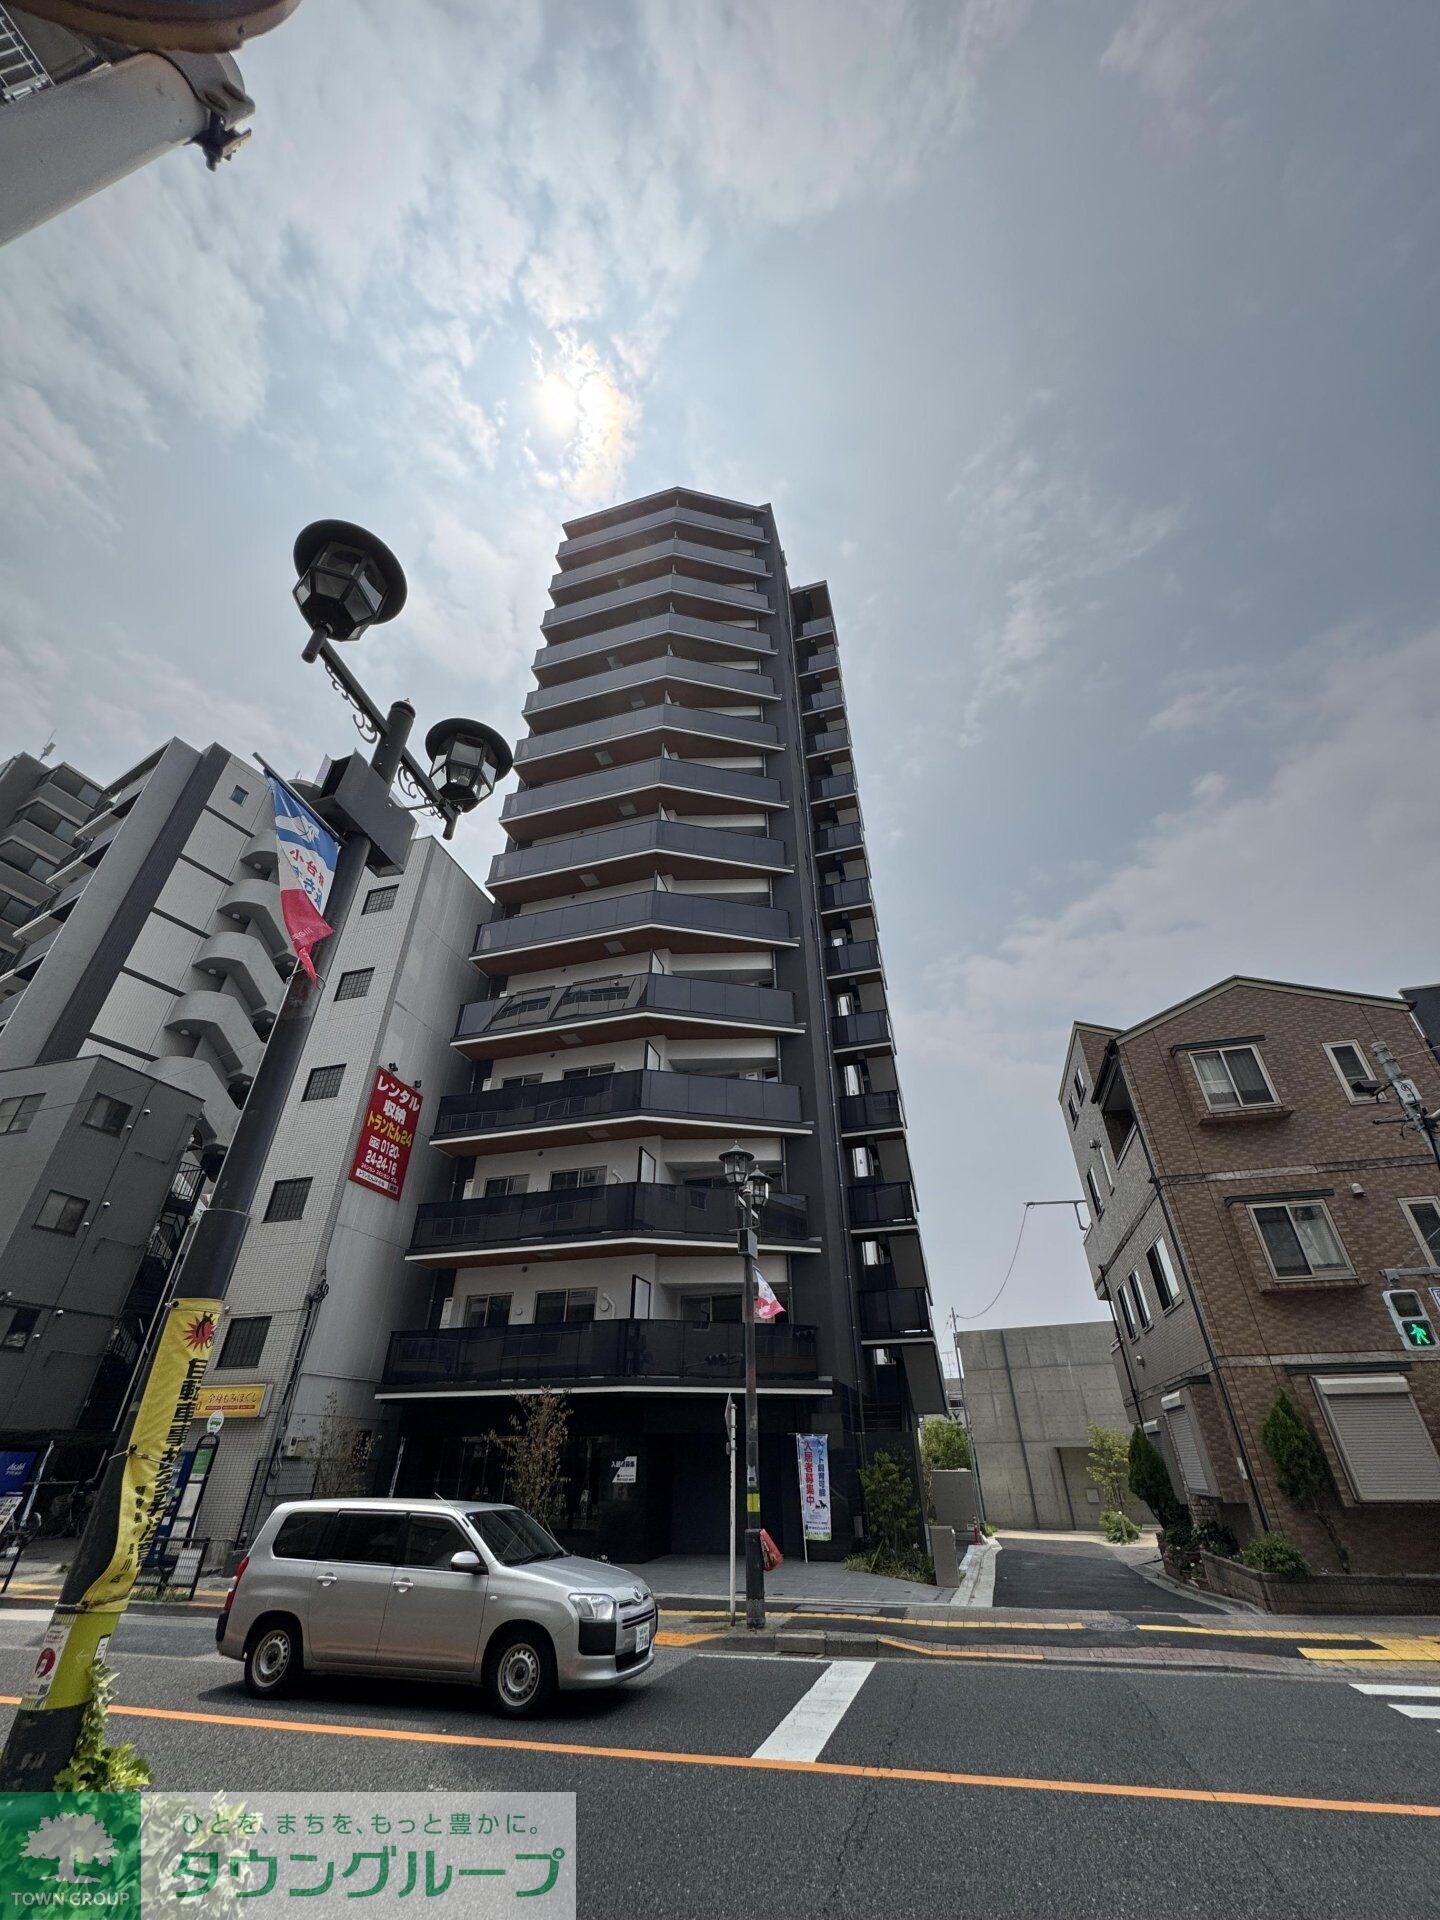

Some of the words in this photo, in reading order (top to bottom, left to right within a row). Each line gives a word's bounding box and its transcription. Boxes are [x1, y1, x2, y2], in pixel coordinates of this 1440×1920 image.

[377, 1075, 420, 1112] レンタル
[382, 1099, 407, 1125] 収納
[367, 1110, 412, 1147] トランたん24
[365, 1150, 397, 1176] 24-24-16
[803, 1440, 815, 1506] 入居者募集中
